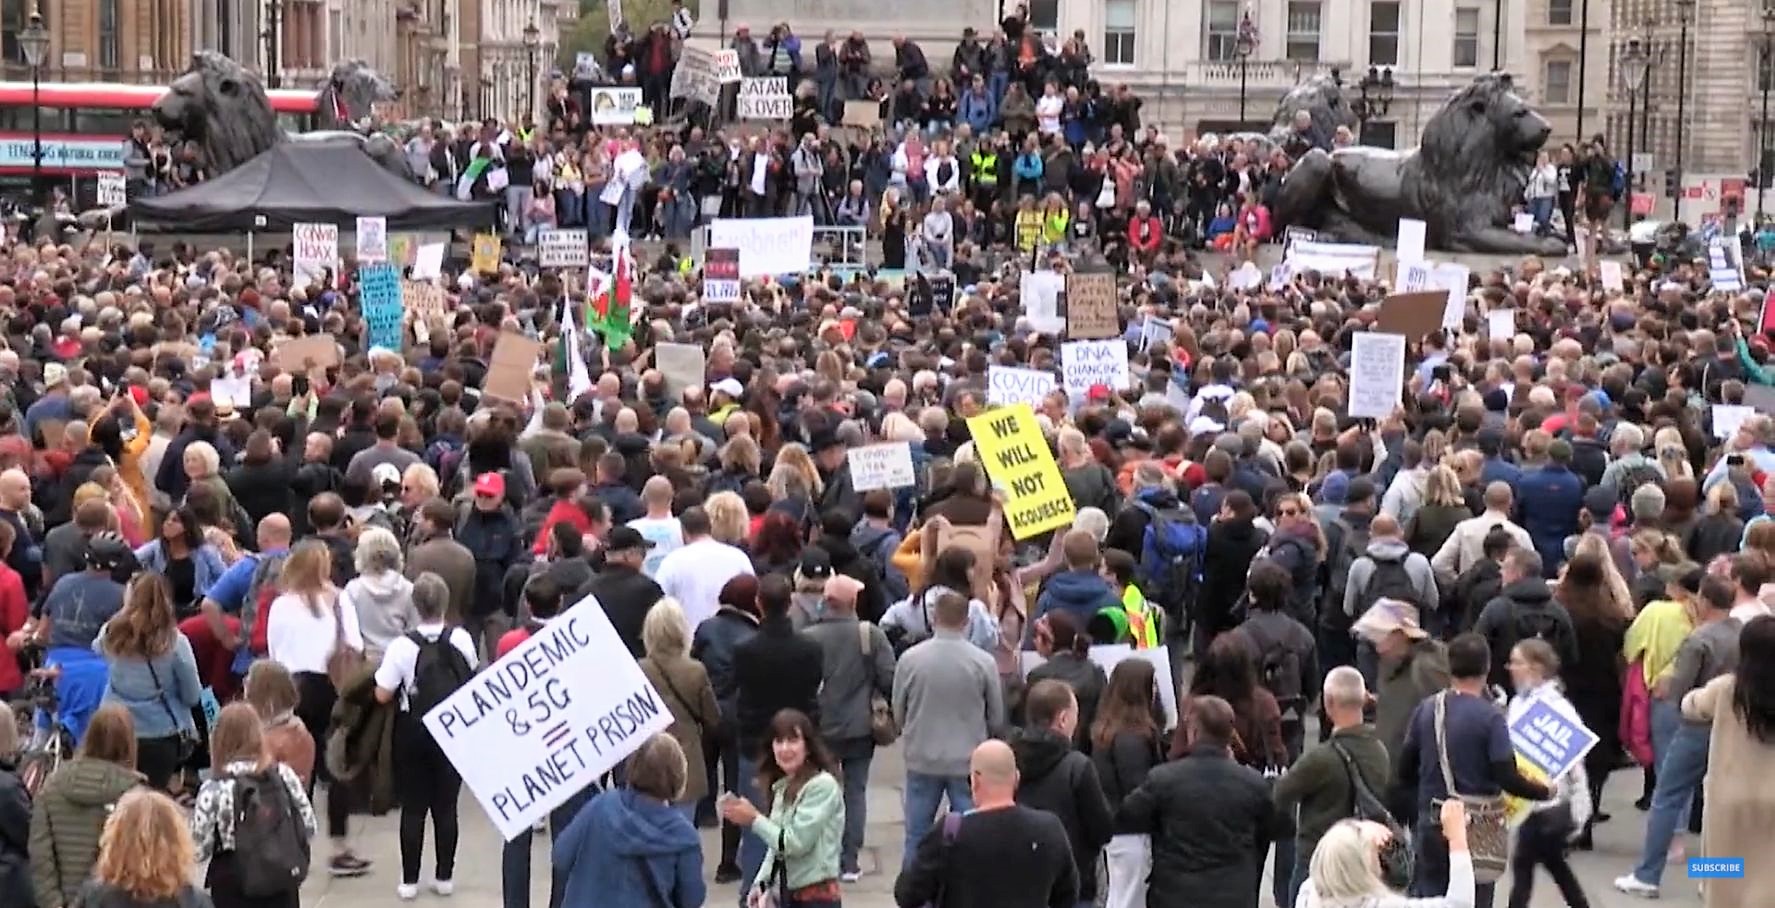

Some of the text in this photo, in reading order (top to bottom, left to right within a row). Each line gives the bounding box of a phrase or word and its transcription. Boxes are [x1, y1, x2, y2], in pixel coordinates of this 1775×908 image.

[741, 79, 785, 96] SATAN
[740, 98, 793, 115] IS OVER
[1075, 344, 1115, 362] DNA
[992, 370, 1051, 396] COVID
[990, 415, 1020, 439] WE
[995, 442, 1038, 469] WILL
[1011, 471, 1045, 499] NOT
[1012, 496, 1071, 529] ACQUIESCE
[438, 617, 590, 738] PLANDEMIC
[1532, 713, 1573, 750] JAIL
[491, 684, 660, 822] PLANET PRISON
